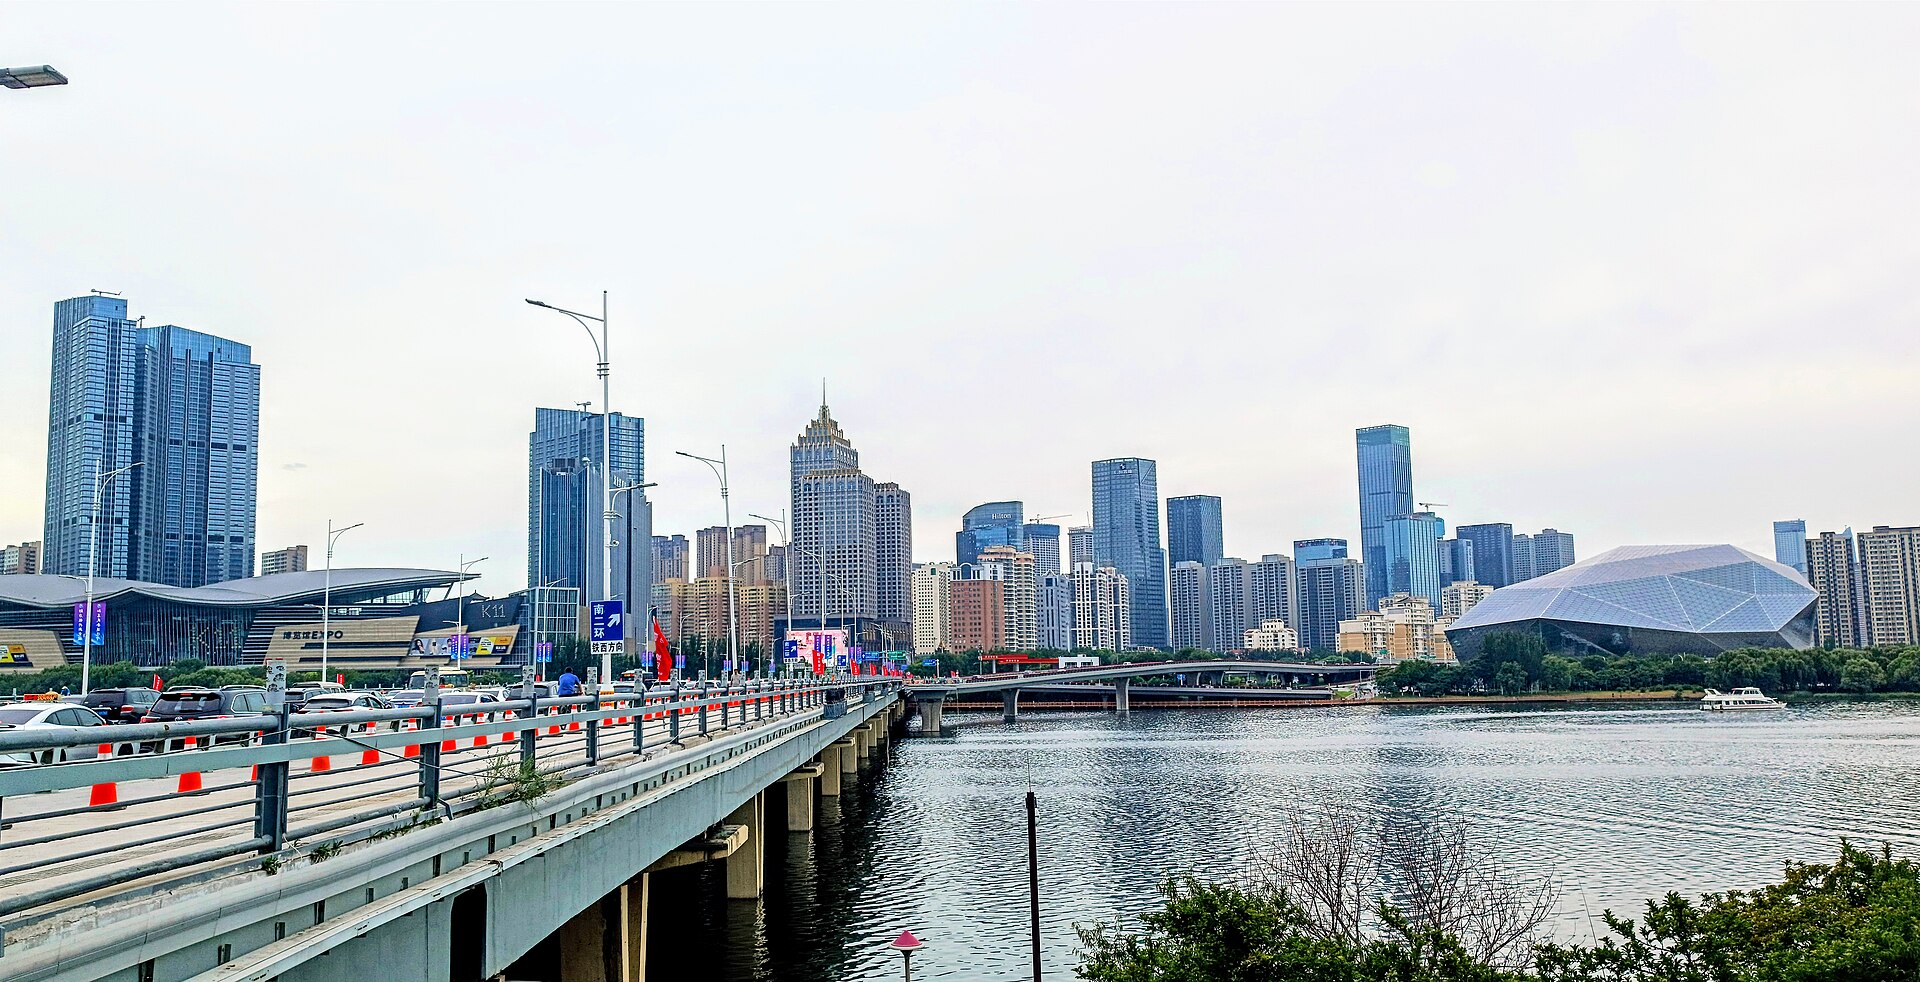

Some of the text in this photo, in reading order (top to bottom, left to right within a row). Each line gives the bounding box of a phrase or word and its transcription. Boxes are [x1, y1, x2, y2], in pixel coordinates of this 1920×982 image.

[481, 604, 506, 618] K11
[593, 604, 605, 638] 南二环
[591, 642, 623, 652] 铁西方向
